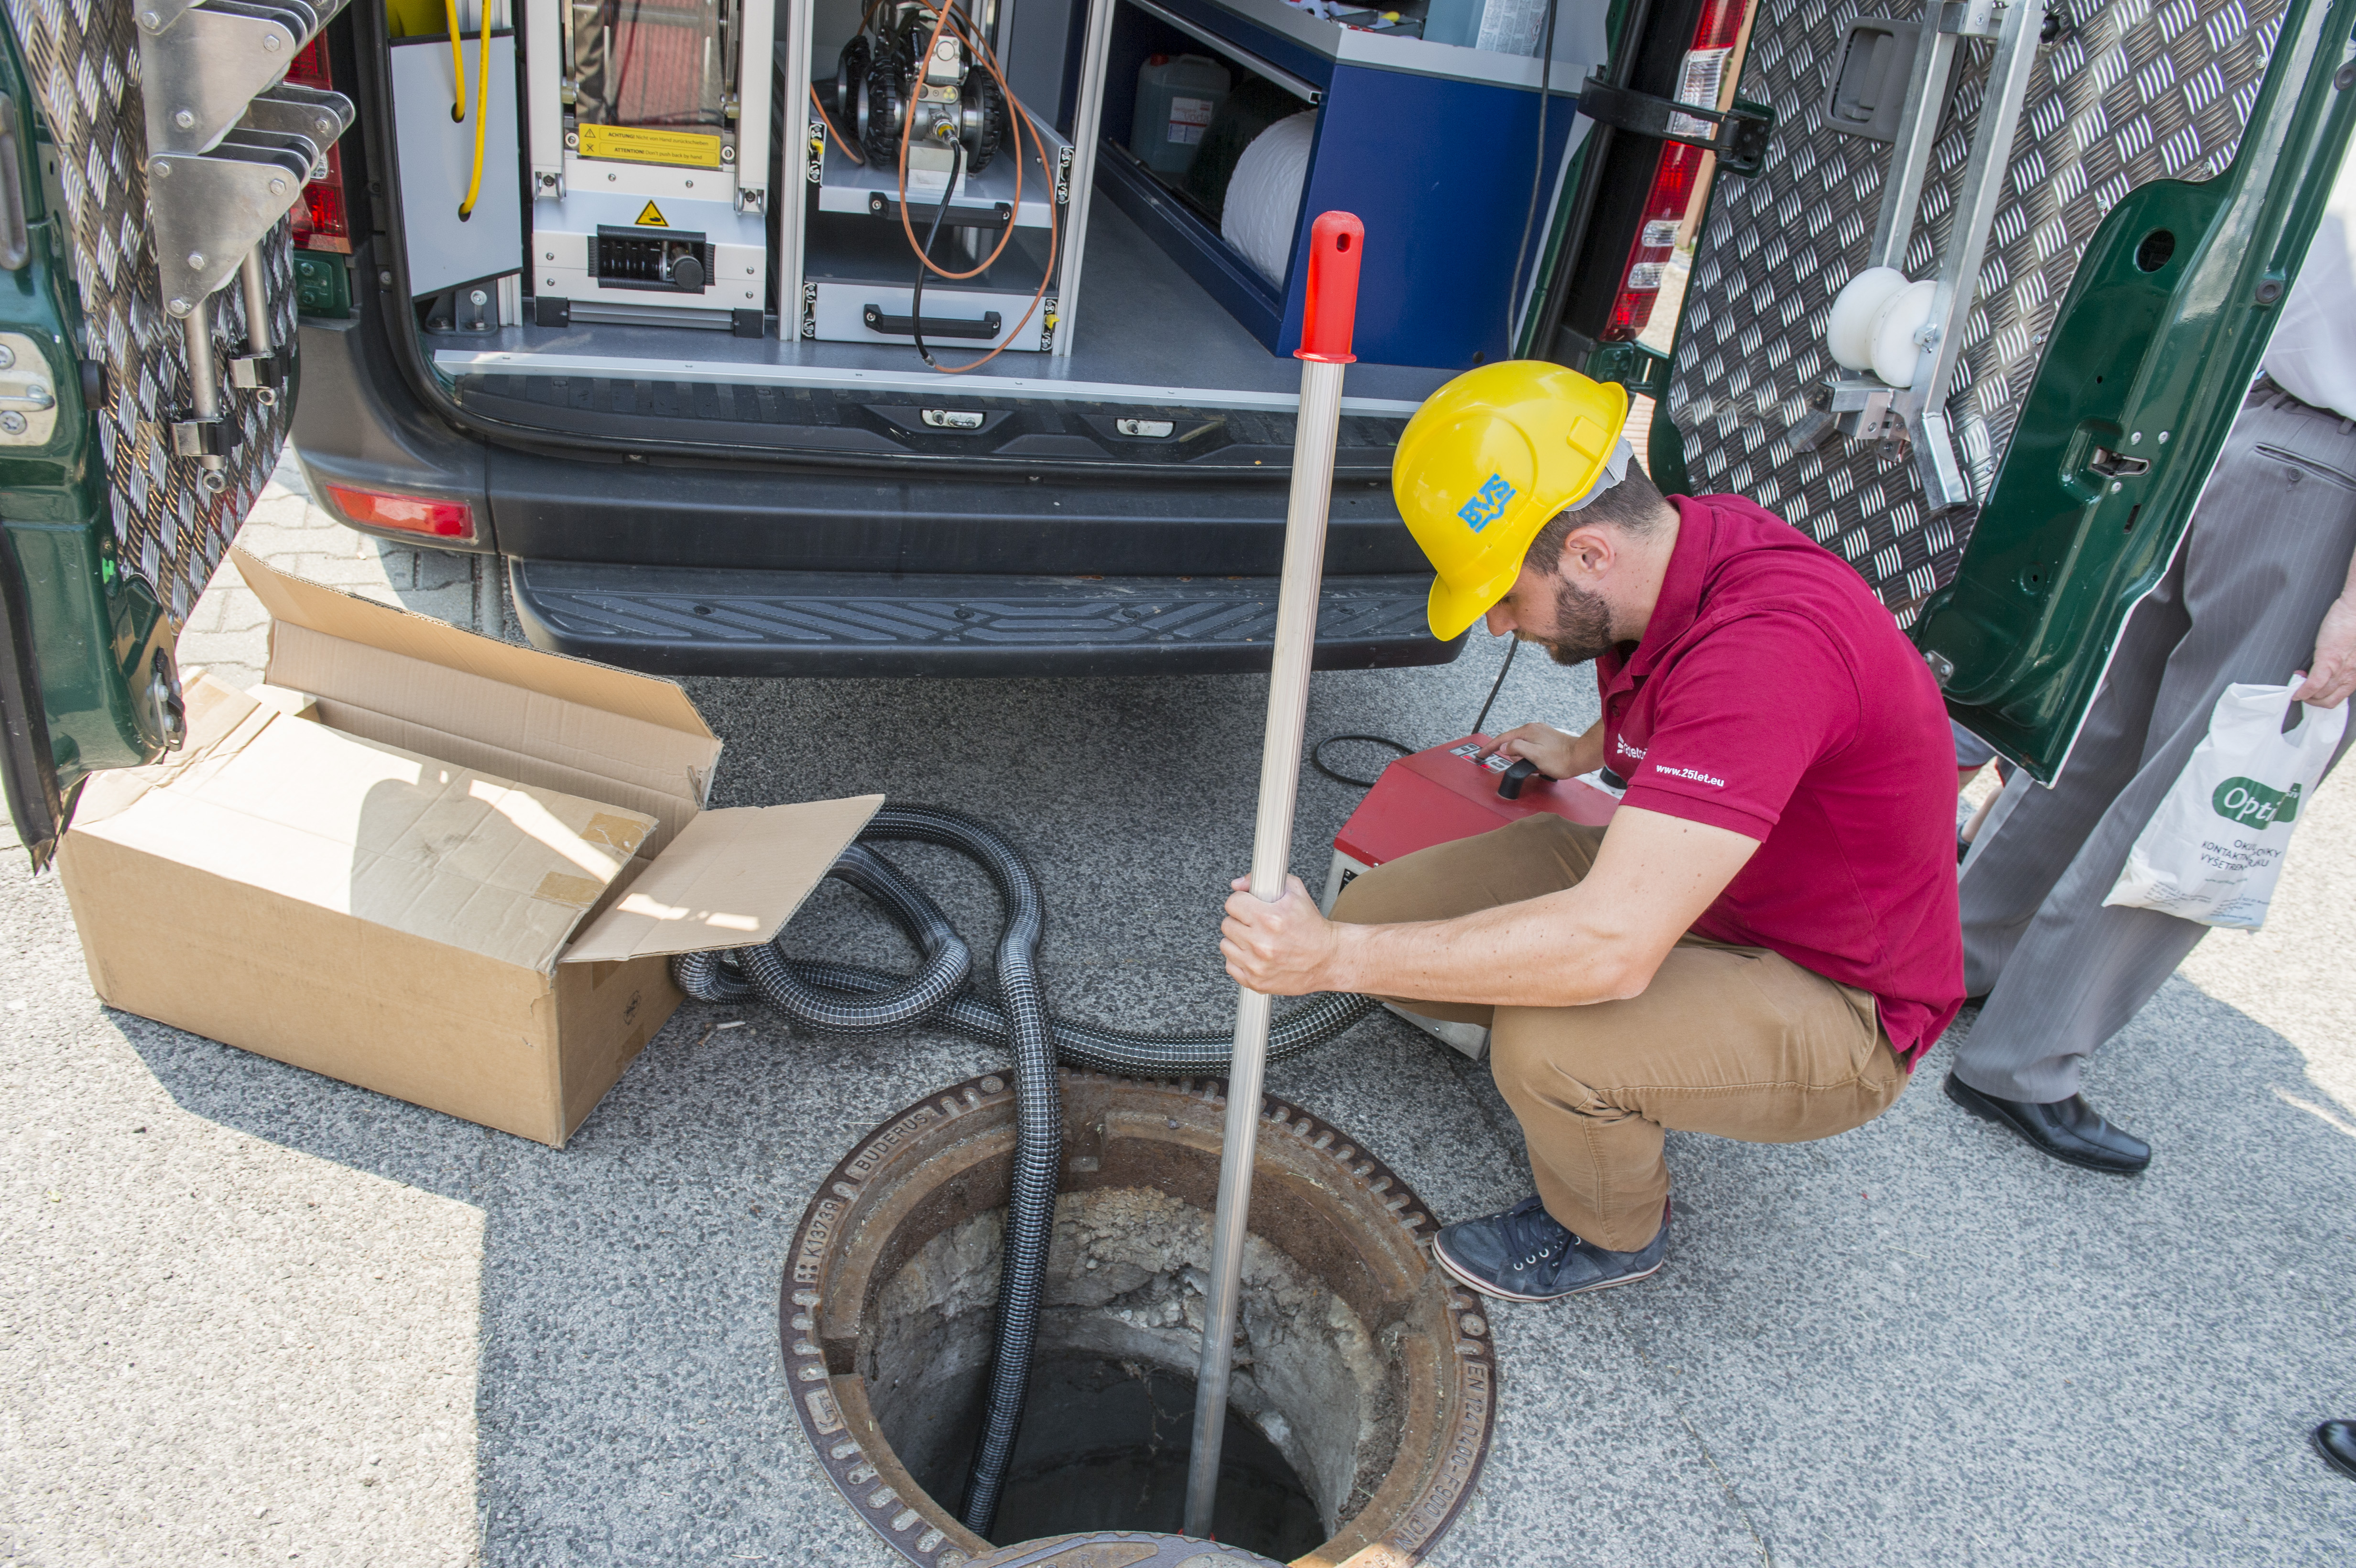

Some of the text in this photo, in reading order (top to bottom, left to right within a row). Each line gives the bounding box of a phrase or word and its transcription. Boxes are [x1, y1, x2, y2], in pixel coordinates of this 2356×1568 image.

[1457, 472, 1511, 530] BVS
[1656, 764, 1724, 787] www.25let.eu
[855, 1113, 928, 1171] BUDERUS
[803, 1202, 839, 1258] K13739
[1468, 1366, 1485, 1392] EN
[1465, 1397, 1482, 1422] 124
[1394, 1516, 1428, 1551] DIN
